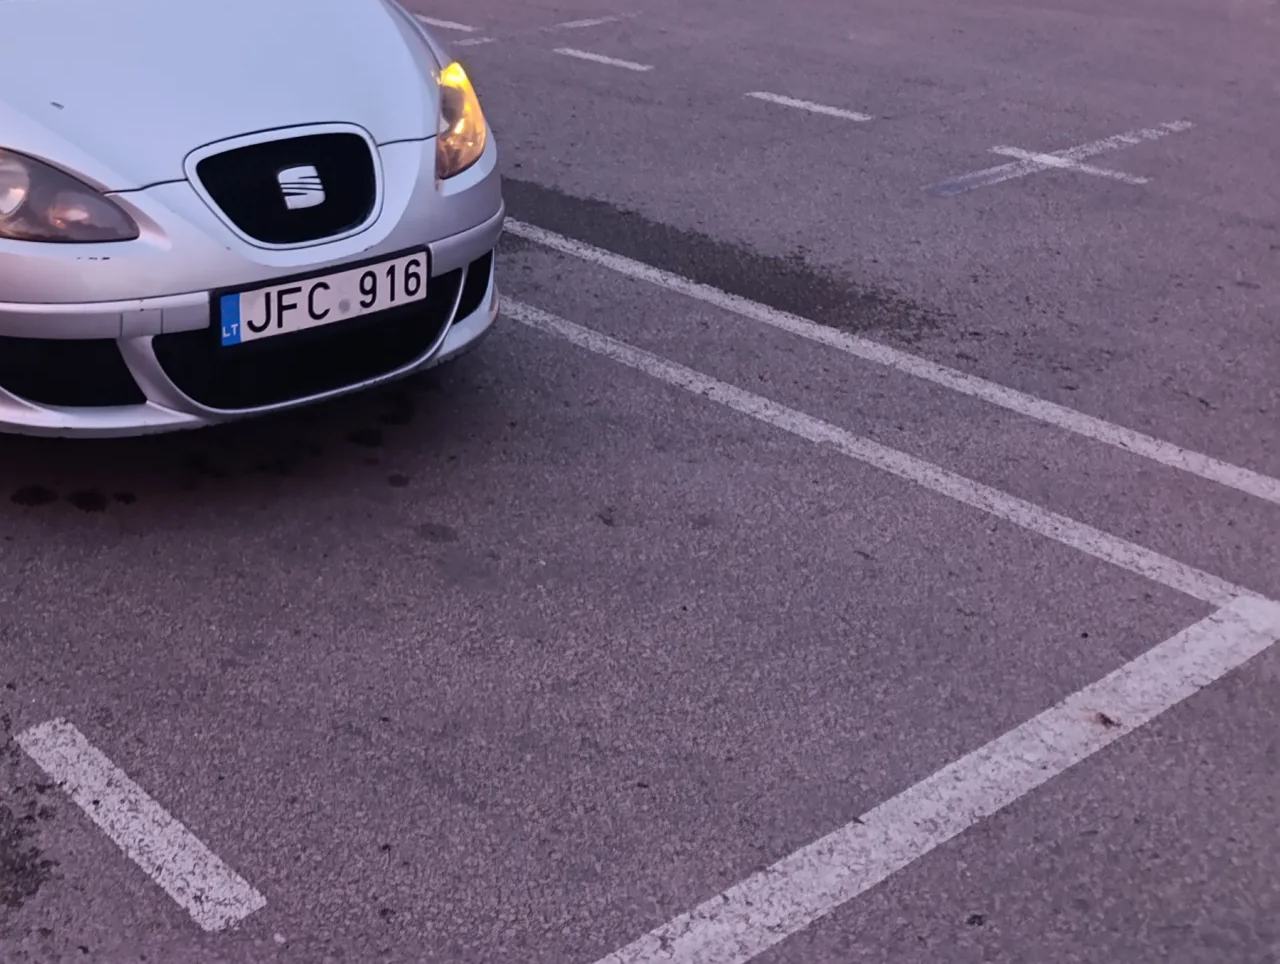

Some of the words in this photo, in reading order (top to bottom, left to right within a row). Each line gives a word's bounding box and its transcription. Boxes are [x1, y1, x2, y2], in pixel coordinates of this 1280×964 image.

[247, 282, 330, 333] JFC
[359, 259, 421, 308] 916
[223, 324, 238, 337] LT
